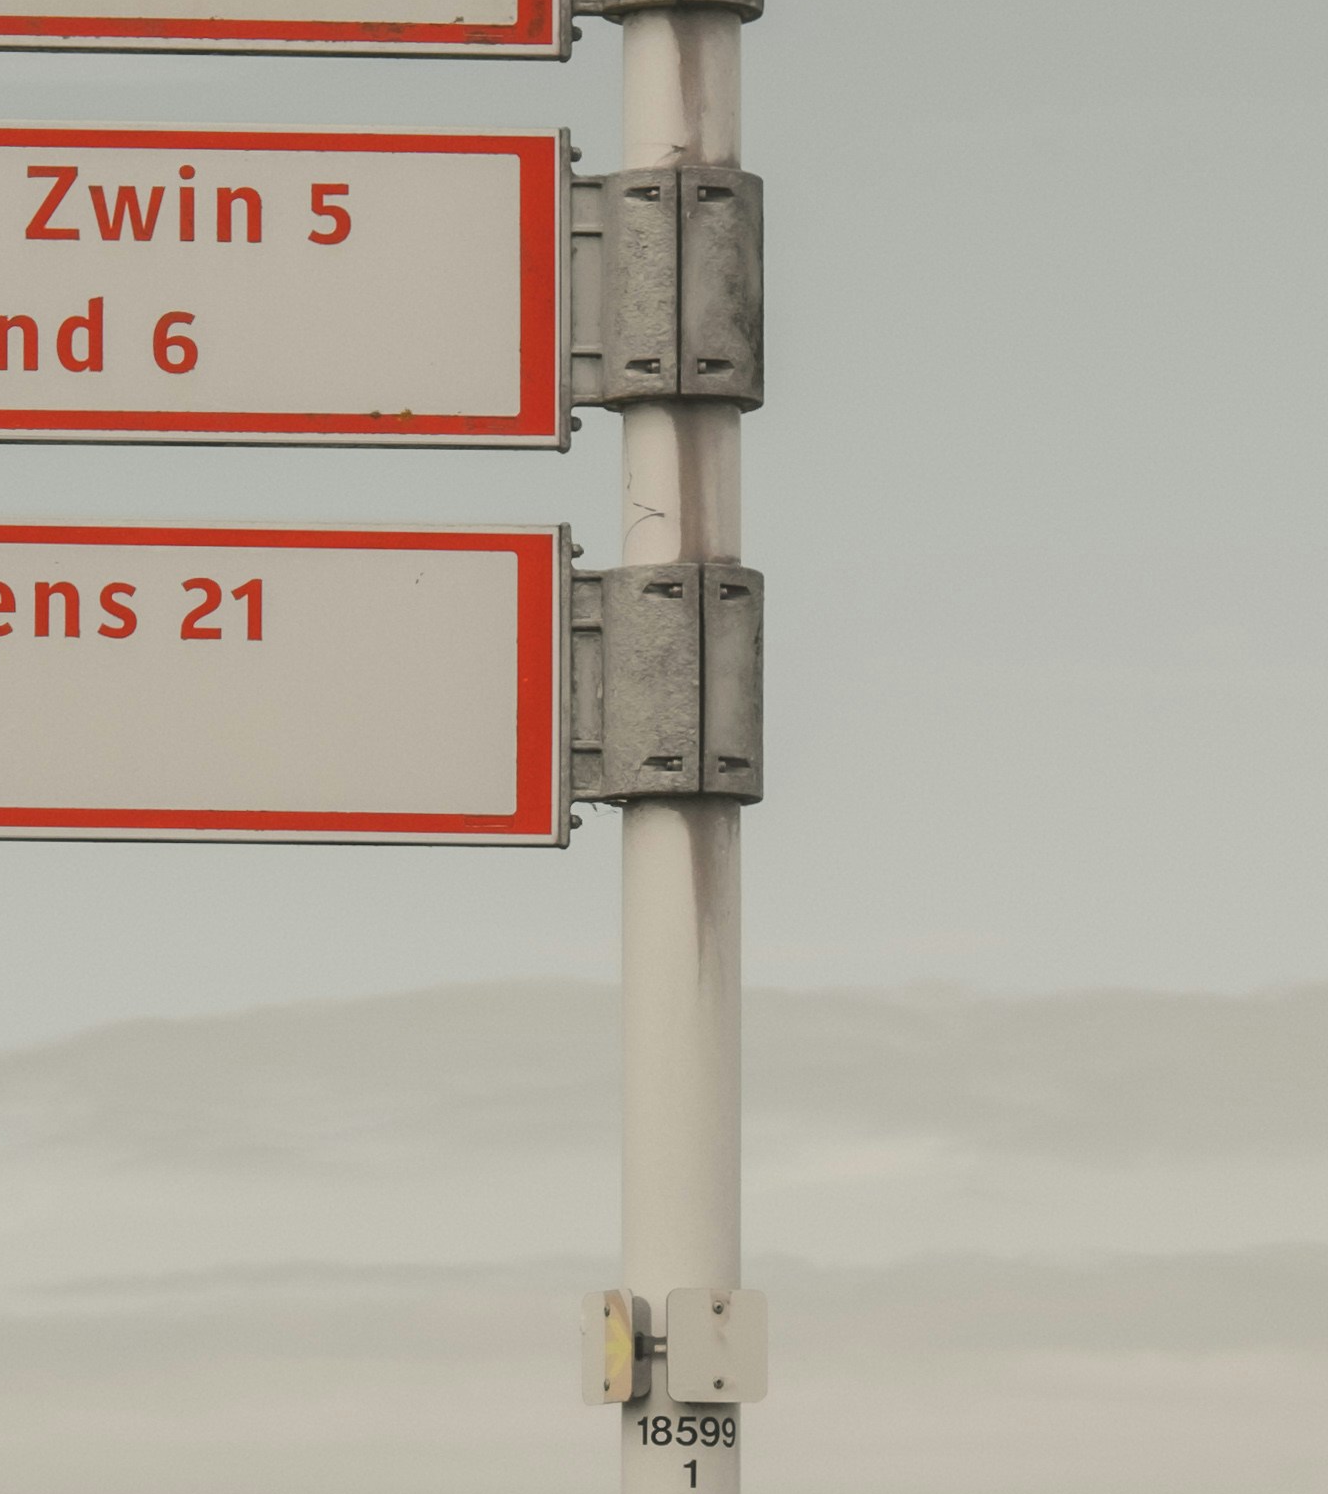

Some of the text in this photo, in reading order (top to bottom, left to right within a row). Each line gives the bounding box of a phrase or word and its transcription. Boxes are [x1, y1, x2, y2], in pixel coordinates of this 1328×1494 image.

[24, 165, 263, 243] Zwin
[308, 182, 353, 245] 5
[153, 311, 199, 374] 6
[179, 577, 264, 641] 21
[637, 1415, 736, 1448] 18599
[683, 1459, 697, 1489] 1
